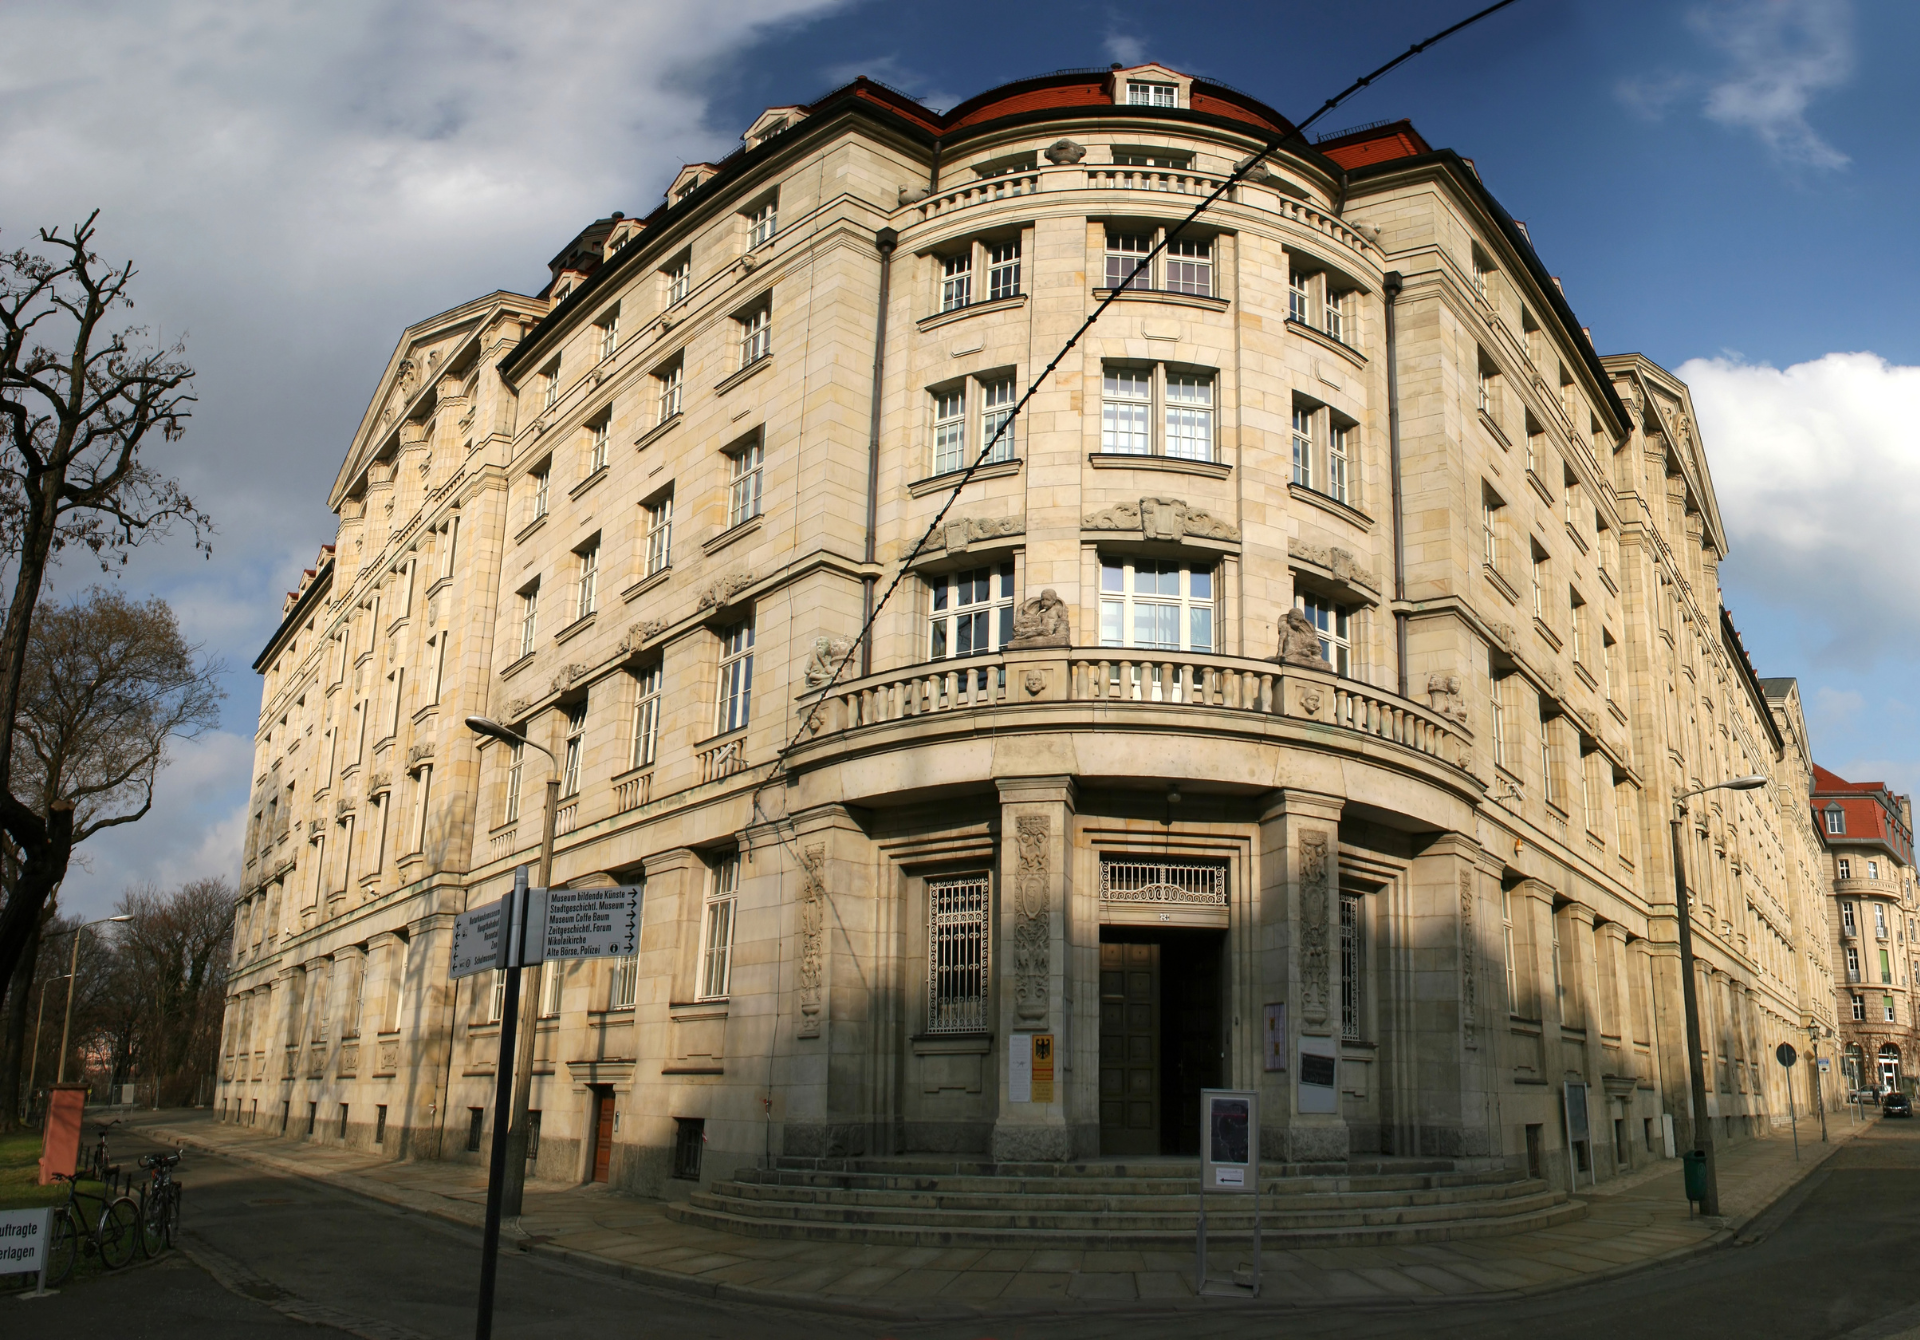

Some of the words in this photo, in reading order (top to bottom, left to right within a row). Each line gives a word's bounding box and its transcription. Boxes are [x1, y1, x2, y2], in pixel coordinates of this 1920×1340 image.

[551, 894, 576, 902] Museum
[578, 892, 602, 900] bildende
[604, 890, 625, 899] Künste
[550, 902, 598, 914] Stadtgeschichtl.
[599, 901, 624, 910] Museum
[549, 915, 574, 924] Museum
[576, 913, 591, 922] Coffe
[592, 912, 610, 921] Baum
[548, 924, 592, 936] Zeitgeschichtl.
[593, 923, 612, 932] Forum
[548, 935, 586, 946] Nikolaikirche
[546, 948, 560, 956] Alte
[580, 945, 600, 954] Polizei
